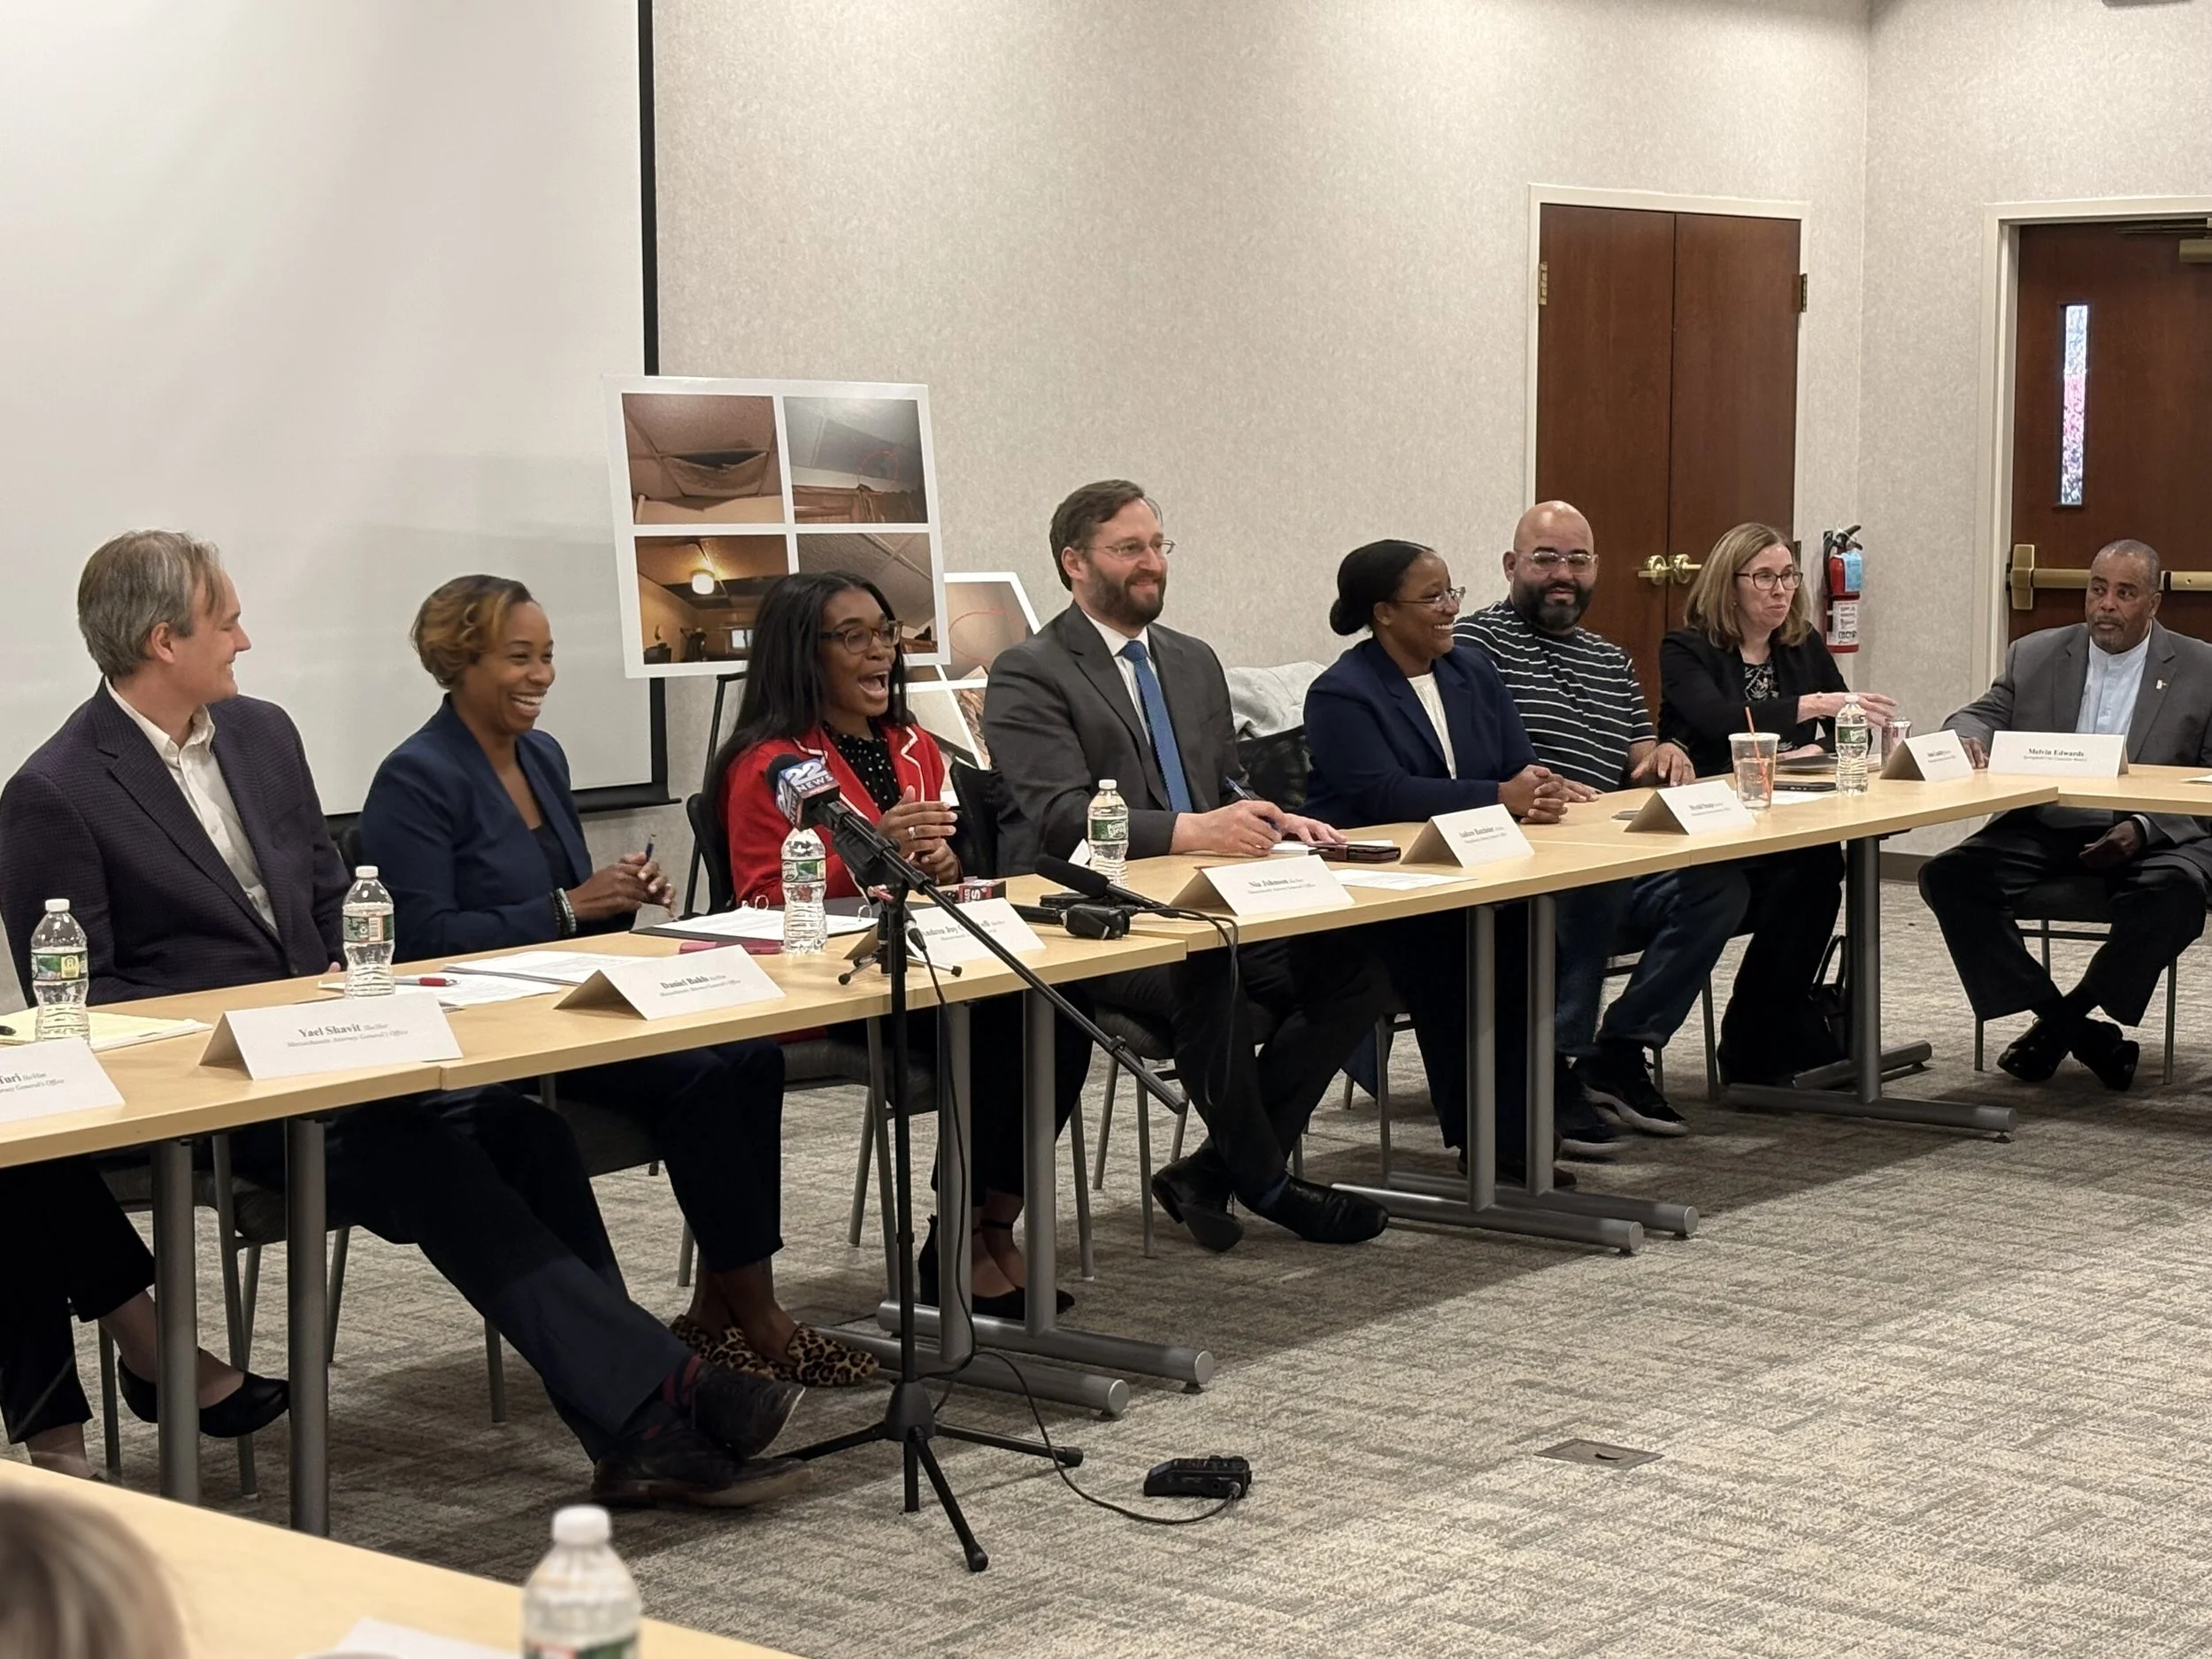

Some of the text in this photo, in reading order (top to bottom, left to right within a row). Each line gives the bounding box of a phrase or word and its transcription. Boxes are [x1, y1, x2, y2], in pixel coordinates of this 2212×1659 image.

[785, 762, 829, 787] 22
[796, 775, 833, 793] NEWS
[298, 1026, 324, 1038] Yael
[325, 1023, 362, 1035] Shavit
